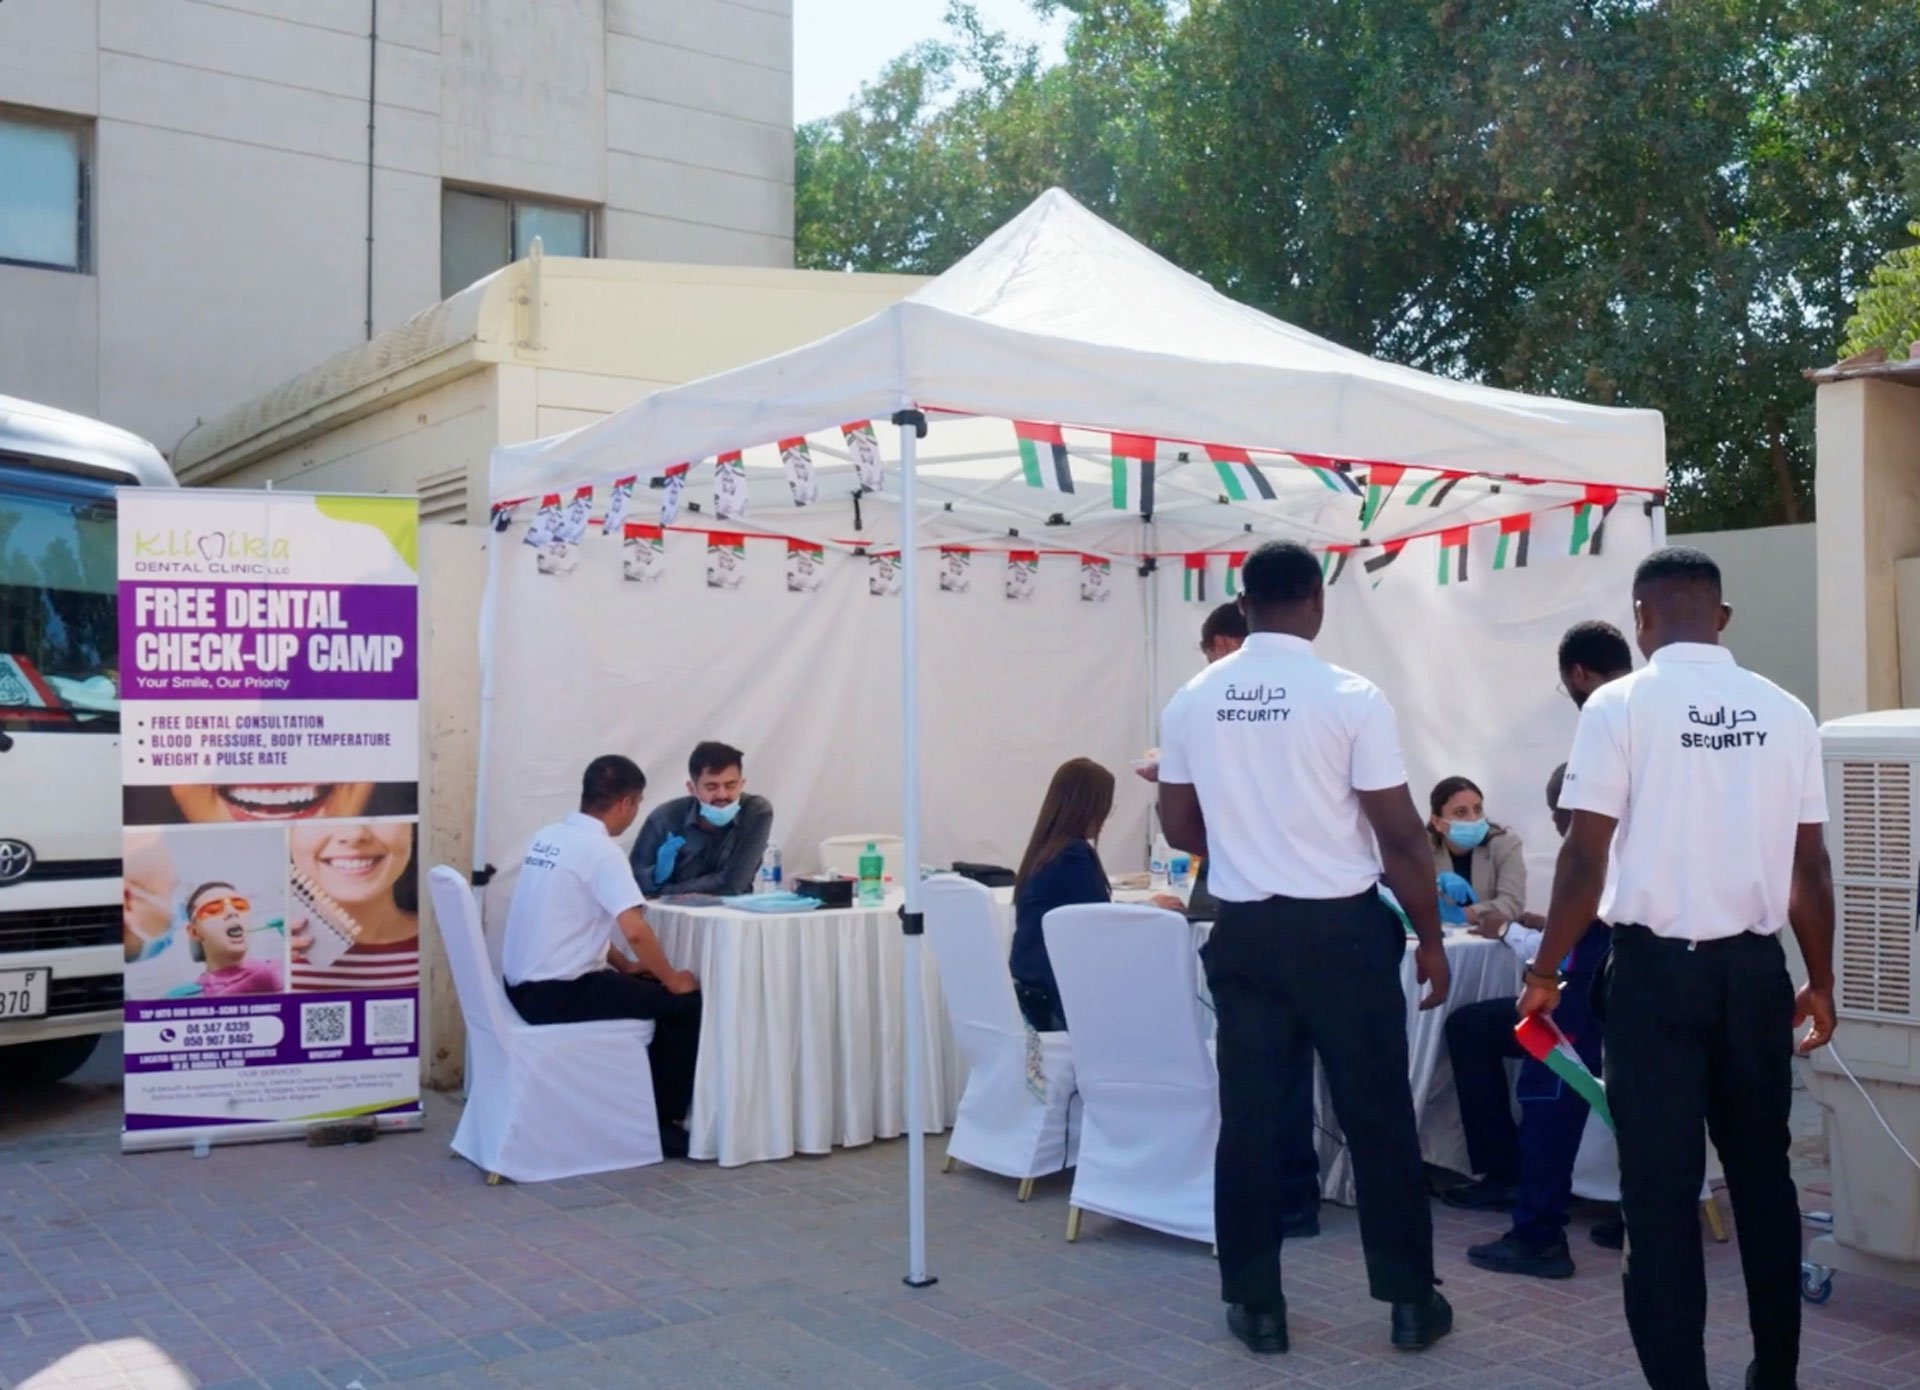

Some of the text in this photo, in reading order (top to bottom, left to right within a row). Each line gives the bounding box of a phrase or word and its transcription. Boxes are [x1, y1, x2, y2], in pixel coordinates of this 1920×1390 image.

[135, 561, 290, 576] DENTAL CLINIC LLC
[135, 587, 348, 629] FREE DENTAL
[135, 633, 404, 672] CHECK-UP CAMP
[136, 676, 290, 691] Your Smile, Our Priority
[1225, 684, 1286, 705] حراسة
[151, 715, 325, 729] FREE DENTAL CONSULTATION
[1216, 708, 1290, 722] SECURITY
[1688, 705, 1757, 730] حراسة
[151, 733, 392, 749] BLOOD PRESSURE, BODY TEMPERATURE
[1681, 731, 1767, 750] SECURITY
[151, 752, 288, 766] WEIGHT & PULSE RATE
[187, 1024, 200, 1034] 04
[203, 1023, 221, 1033] 347
